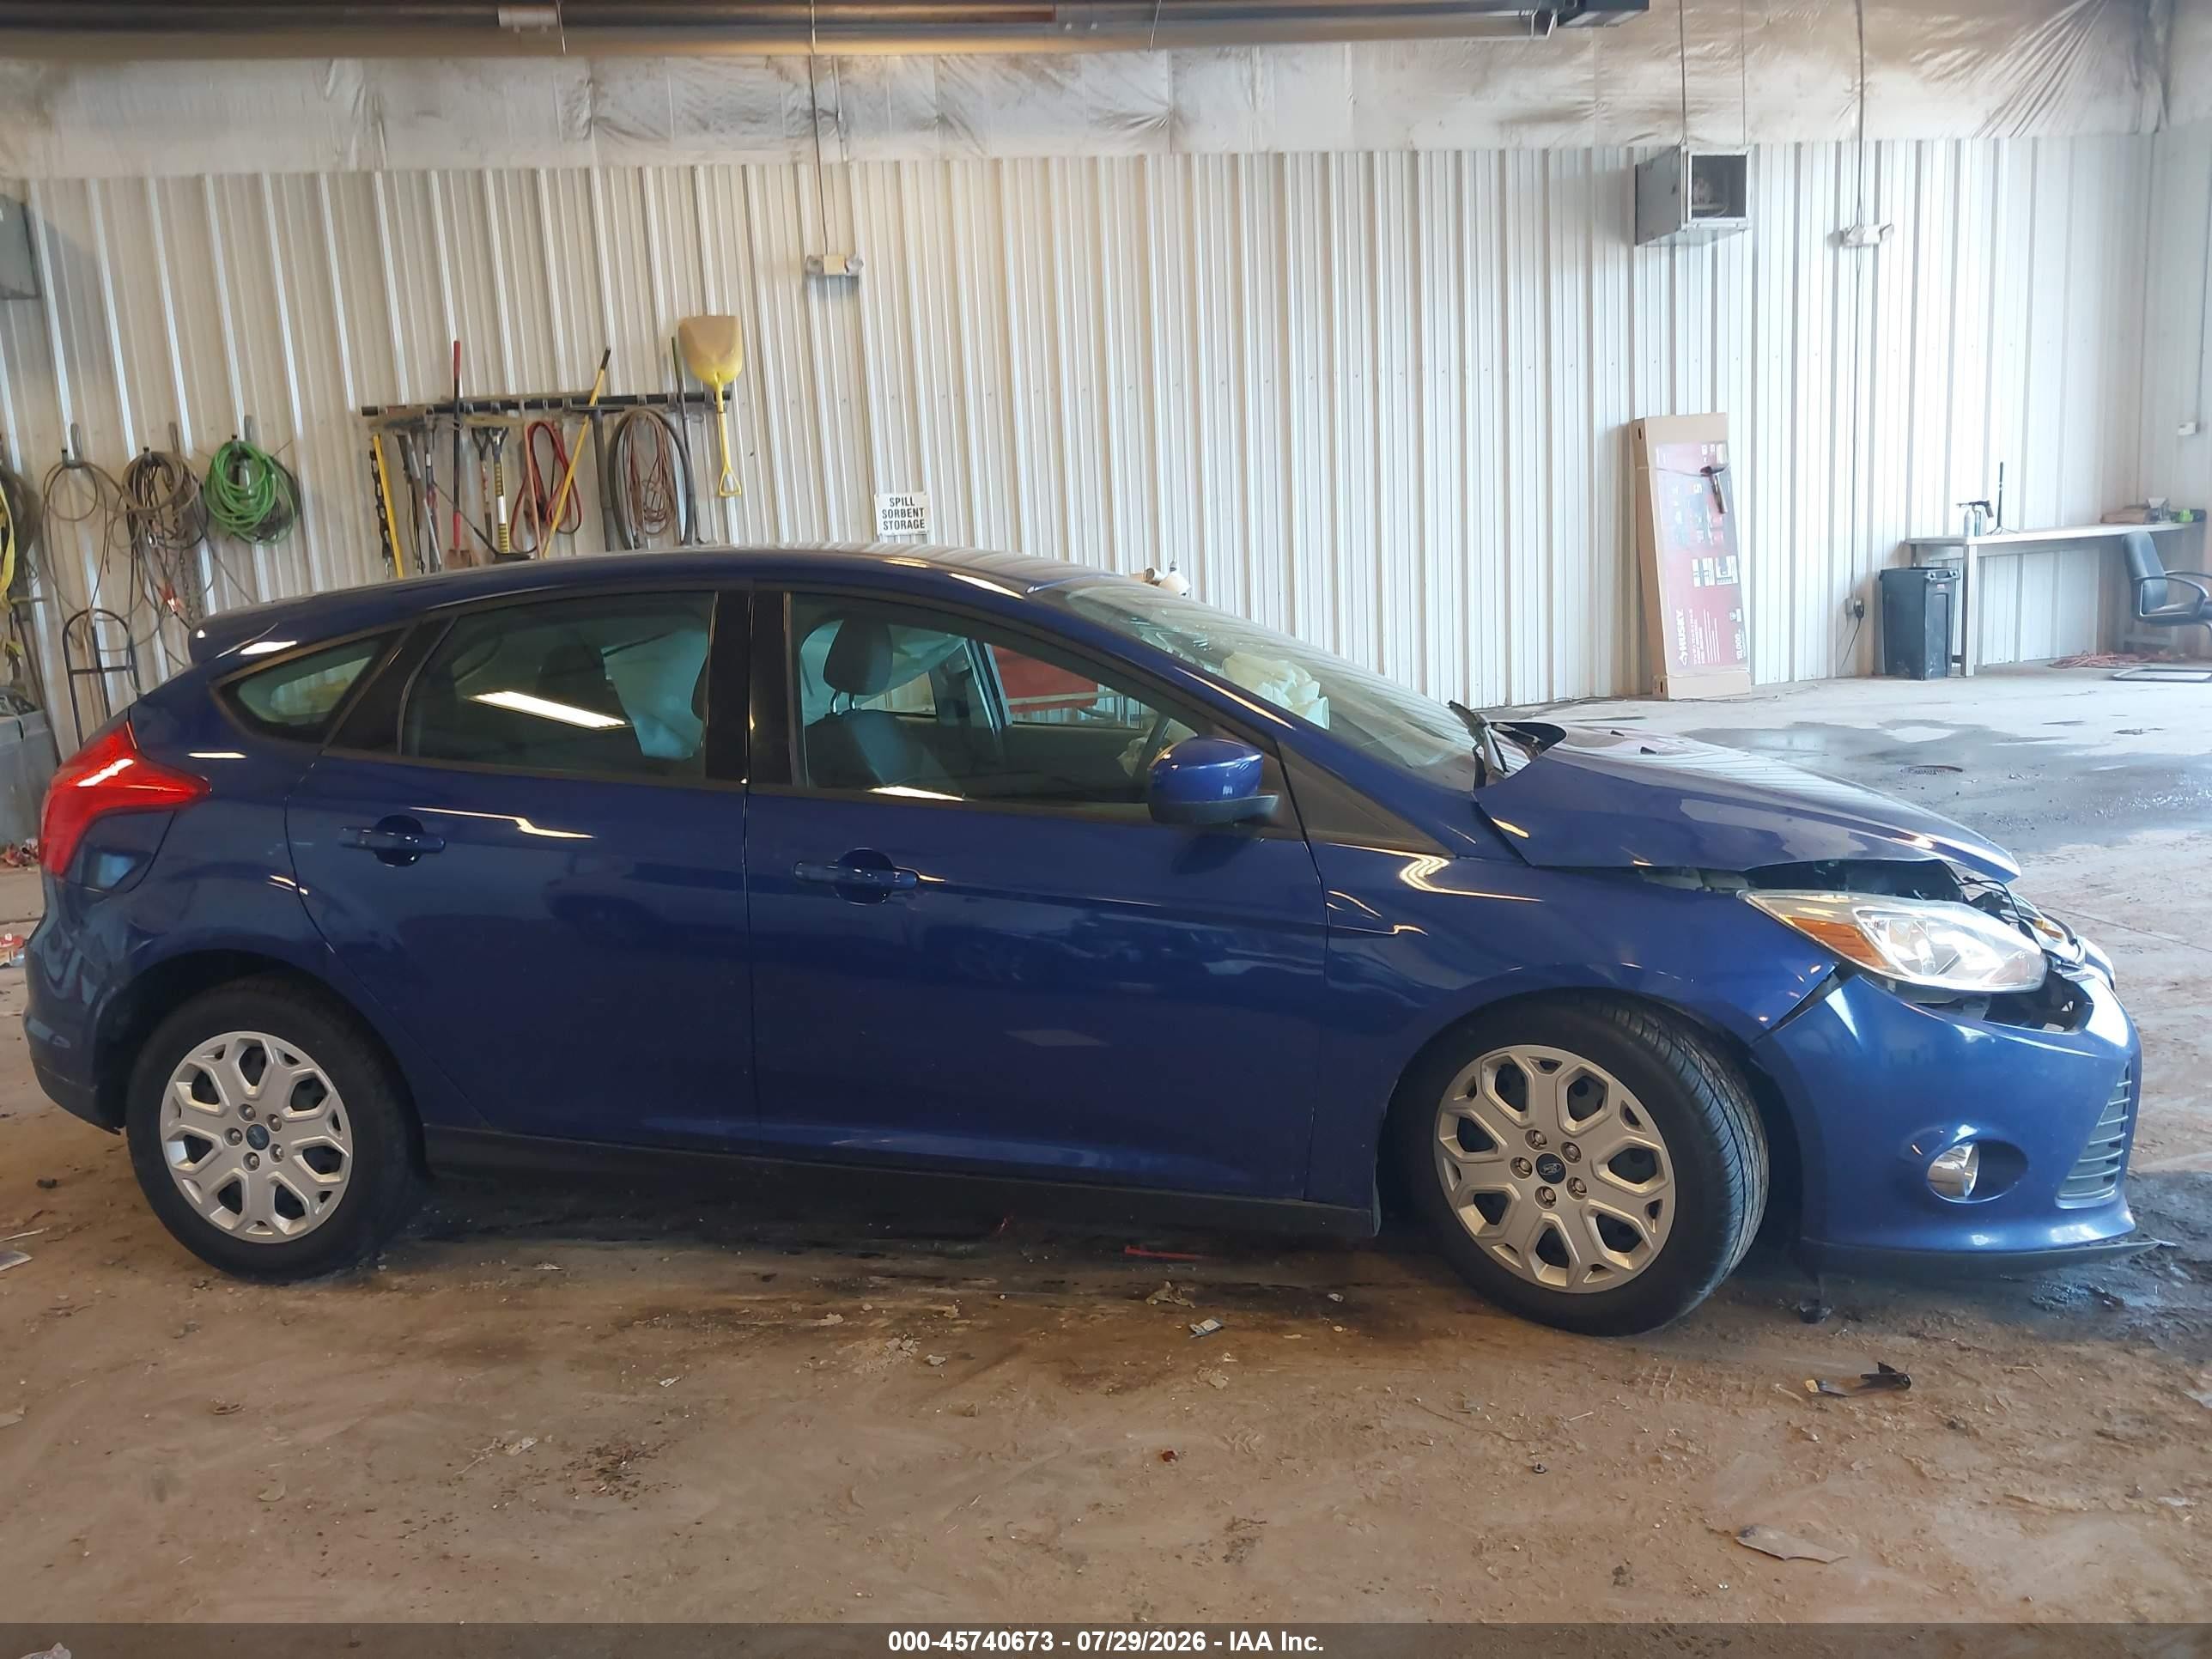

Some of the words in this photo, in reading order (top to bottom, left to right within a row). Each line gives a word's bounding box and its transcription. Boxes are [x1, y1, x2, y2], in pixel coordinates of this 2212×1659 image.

[890, 495, 915, 507] SPILL
[882, 507, 925, 519] SORBENT
[883, 519, 926, 531] STORAGE
[1676, 609, 1687, 651] HUSKY
